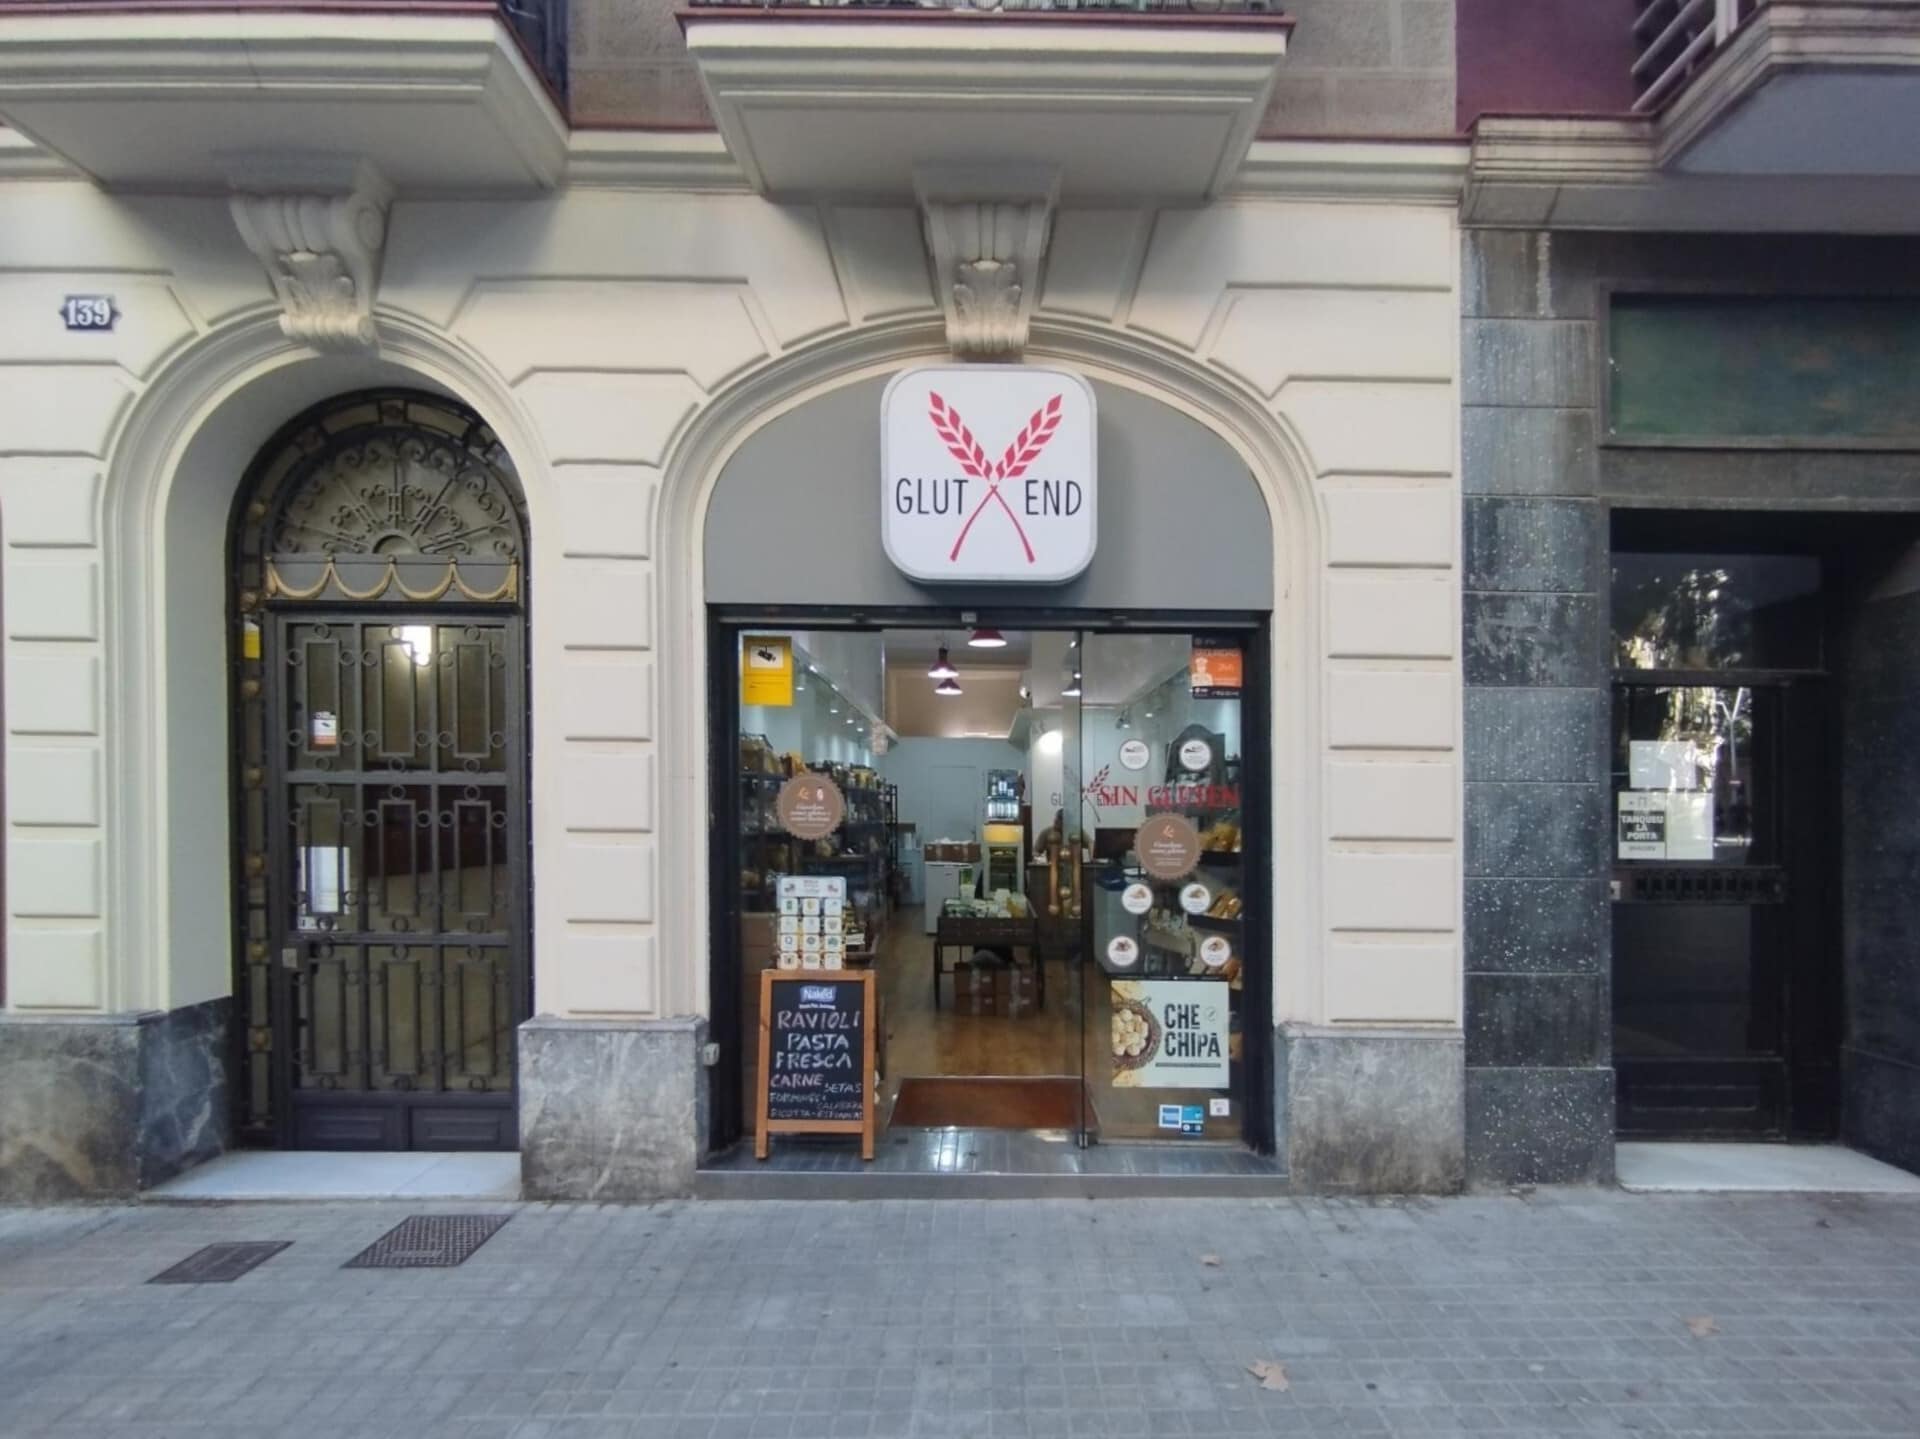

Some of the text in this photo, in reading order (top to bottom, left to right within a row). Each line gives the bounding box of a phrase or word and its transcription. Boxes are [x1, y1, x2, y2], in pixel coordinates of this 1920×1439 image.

[68, 299, 110, 326] 139
[896, 478, 1082, 516] GLUT END
[1100, 785, 1138, 806] SIN
[778, 1010, 860, 1029] RAVIOLI
[1164, 1003, 1201, 1030] CHE
[787, 1032, 850, 1051] PASTA
[775, 1050, 852, 1069] FRESCA
[769, 1072, 825, 1089] CARNE
